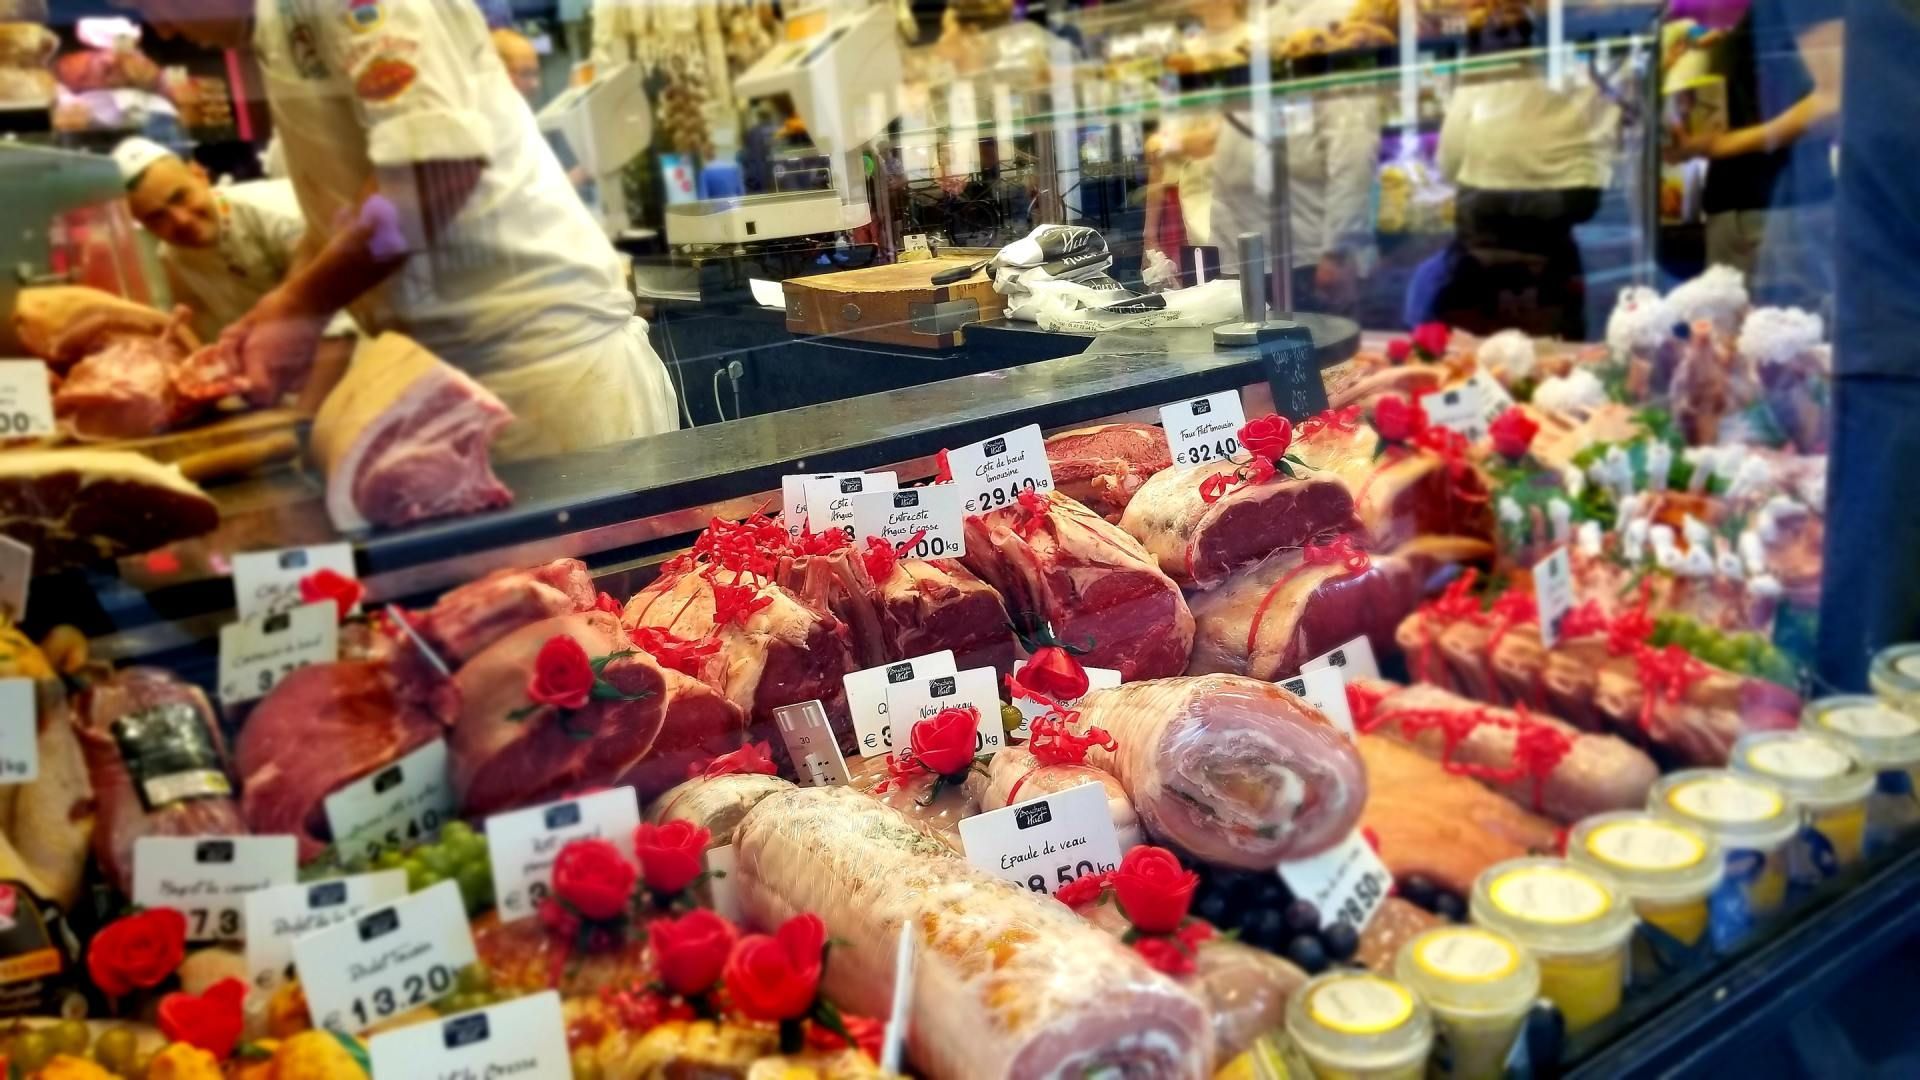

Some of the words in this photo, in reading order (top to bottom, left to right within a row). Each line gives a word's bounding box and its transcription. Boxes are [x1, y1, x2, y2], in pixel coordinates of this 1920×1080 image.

[1180, 428, 1196, 441] Faux
[976, 462, 995, 476] Côte
[996, 458, 1005, 469] de
[829, 498, 849, 511] Côte
[889, 509, 929, 524] Entrecôte
[881, 525, 907, 537] Angus
[919, 704, 938, 719] Noix
[1026, 811, 1047, 825] Huet
[1000, 845, 1039, 870] Epaule
[1043, 840, 1056, 855] de
[1059, 835, 1087, 850] veau
